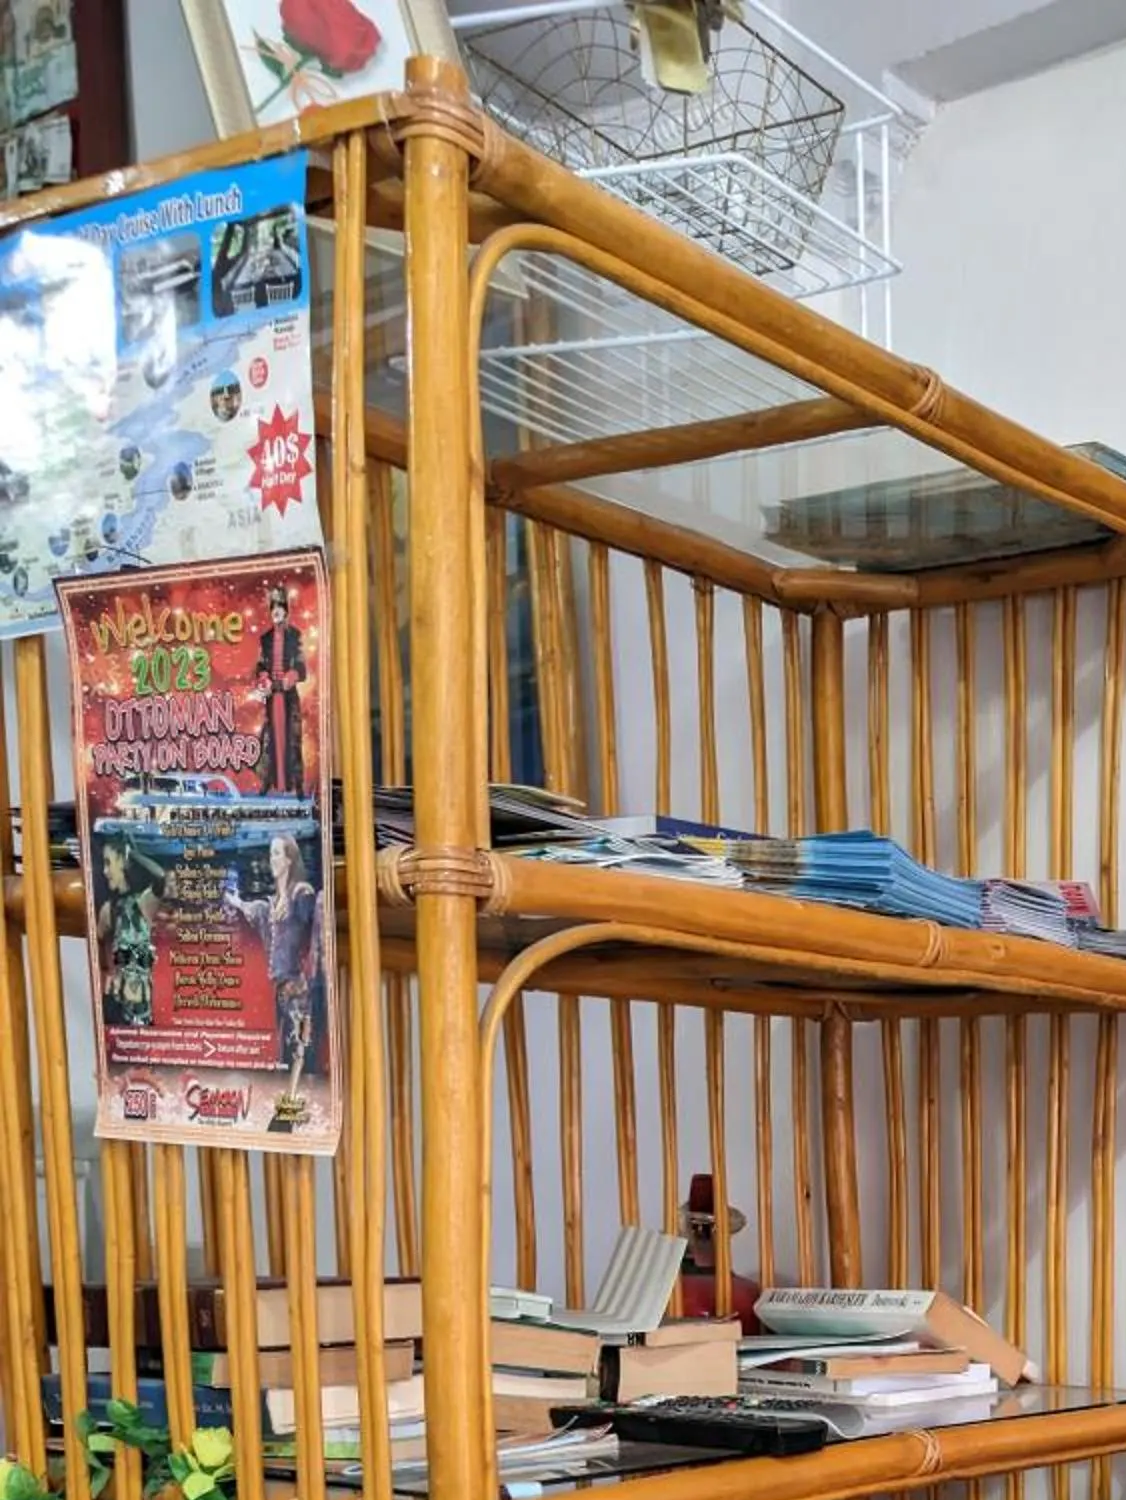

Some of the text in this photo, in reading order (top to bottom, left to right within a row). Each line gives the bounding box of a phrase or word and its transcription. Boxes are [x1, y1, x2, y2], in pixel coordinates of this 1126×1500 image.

[116, 208, 159, 243] Cruise
[158, 192, 195, 231] With
[195, 181, 244, 223] Lunch
[260, 432, 300, 471] 40$
[227, 506, 262, 530] ASIA
[90, 593, 244, 650] Welcome
[131, 646, 212, 695] 2023
[104, 692, 236, 742] OTTOMAN
[91, 733, 262, 777] PARTY ON BOARD
